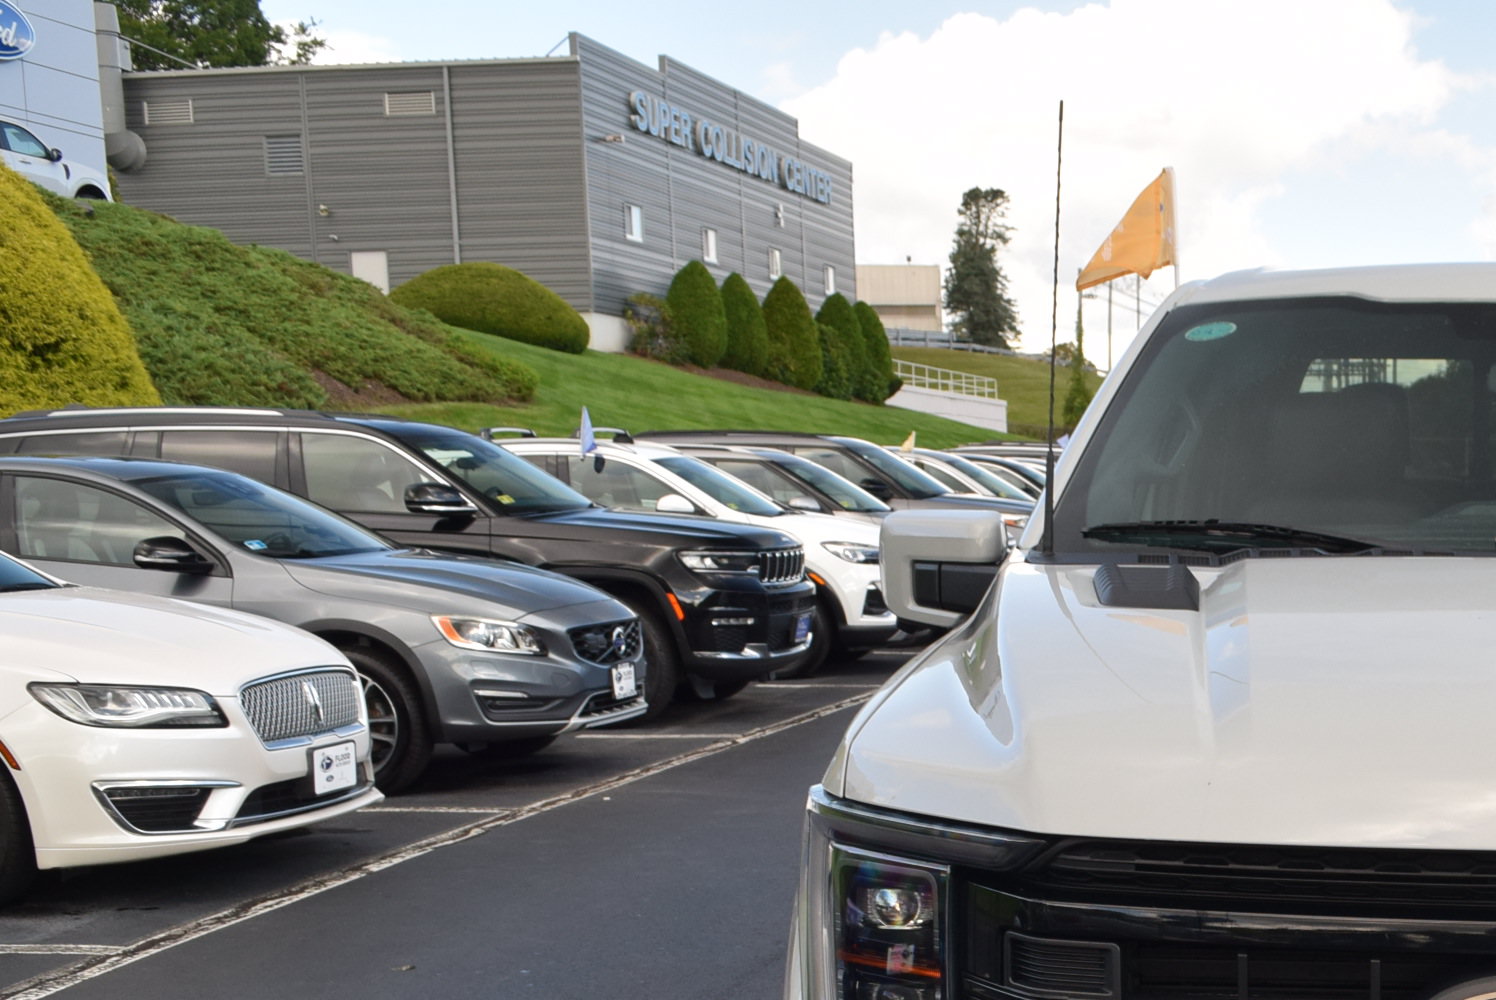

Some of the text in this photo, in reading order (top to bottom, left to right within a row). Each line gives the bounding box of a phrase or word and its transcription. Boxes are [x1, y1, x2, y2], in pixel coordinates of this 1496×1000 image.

[630, 90, 833, 204] SUPER COLLISION CENTER
